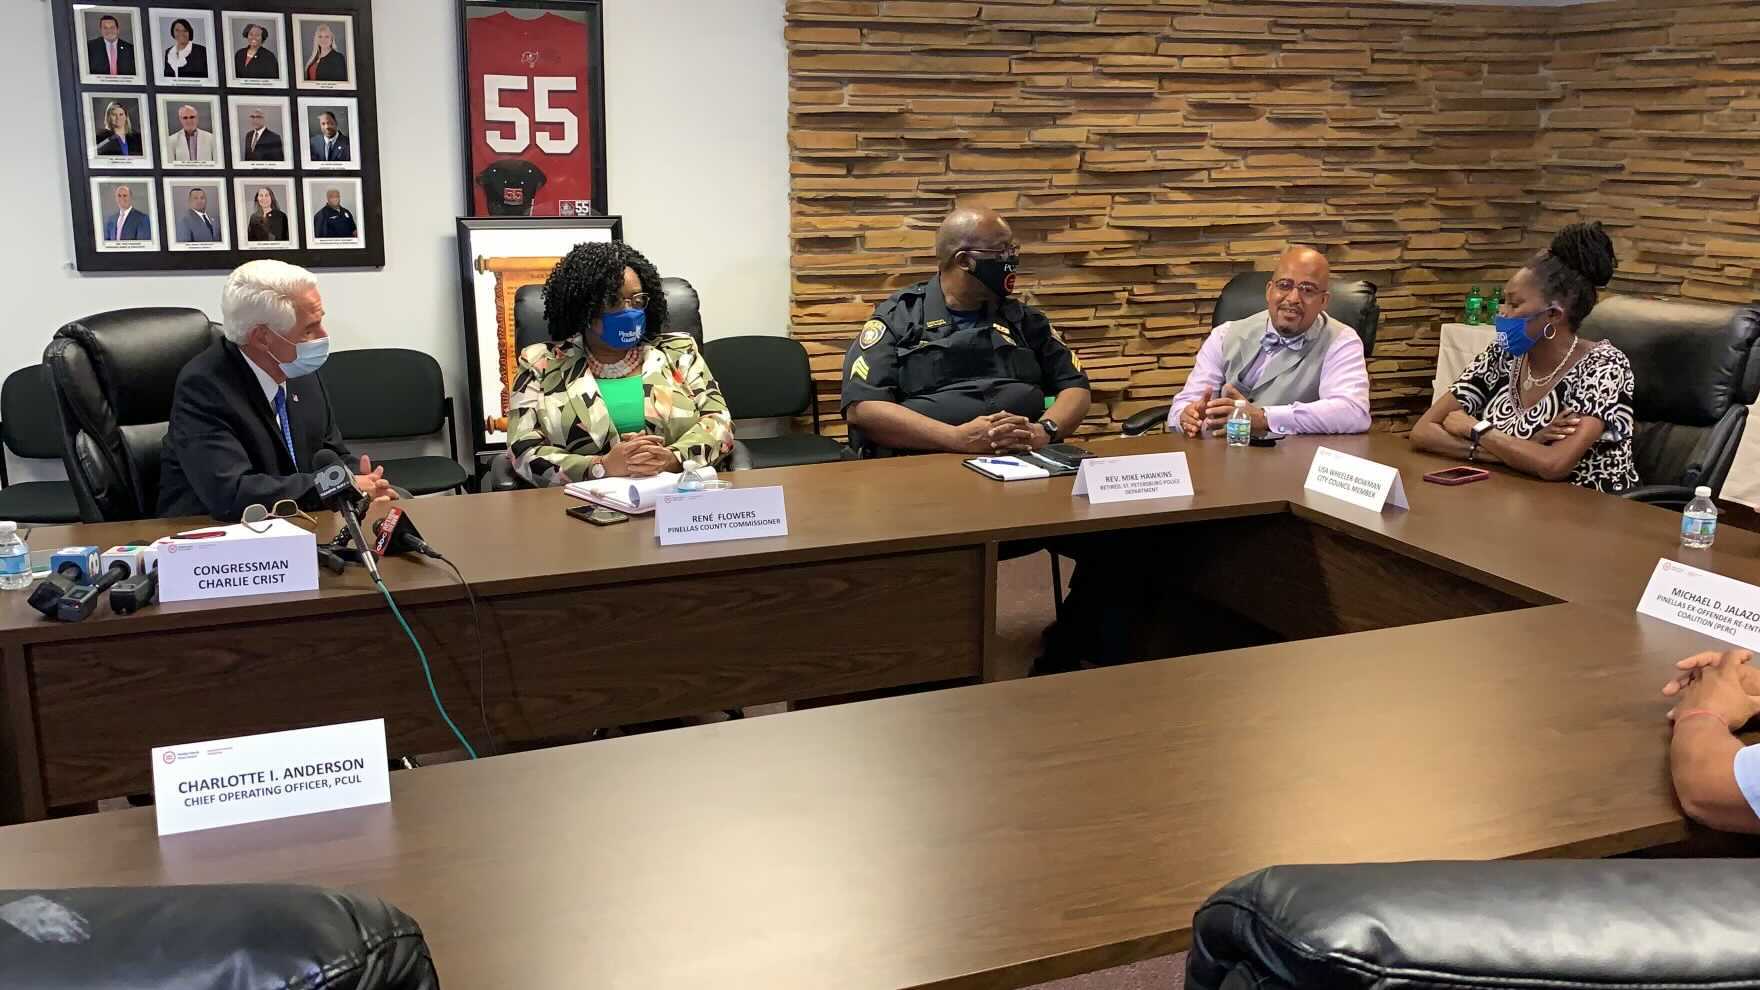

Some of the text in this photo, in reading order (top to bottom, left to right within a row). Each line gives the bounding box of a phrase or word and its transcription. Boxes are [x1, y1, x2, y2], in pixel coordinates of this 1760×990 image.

[483, 74, 579, 154] 55
[575, 201, 589, 213] 55
[314, 465, 346, 491] 10
[1105, 471, 1172, 483] REV. MIKE HAWKINS
[1329, 469, 1353, 482] WHEELER
[1354, 476, 1382, 491] BOWMAN
[1125, 487, 1159, 495] DEPARTMENT
[1316, 474, 1376, 498] CITY COUNCIL MEMBER
[692, 510, 756, 523] RENÉ FLOWERS
[667, 518, 781, 534] PINELLAS COUNTY COMMISSIONER
[193, 560, 289, 576] CONGRESSMAN
[198, 573, 286, 590] CHARLIE CRIST
[1656, 595, 1687, 609] PINELLAS
[1671, 587, 1711, 607] MICHAEL
[1713, 600, 1722, 611] D.
[1677, 611, 1714, 627] COALITION
[178, 757, 365, 794] CHARLOTTE I. ANDERSON
[184, 774, 363, 808] CHIEF OPERATING OFFICER, PCUL
